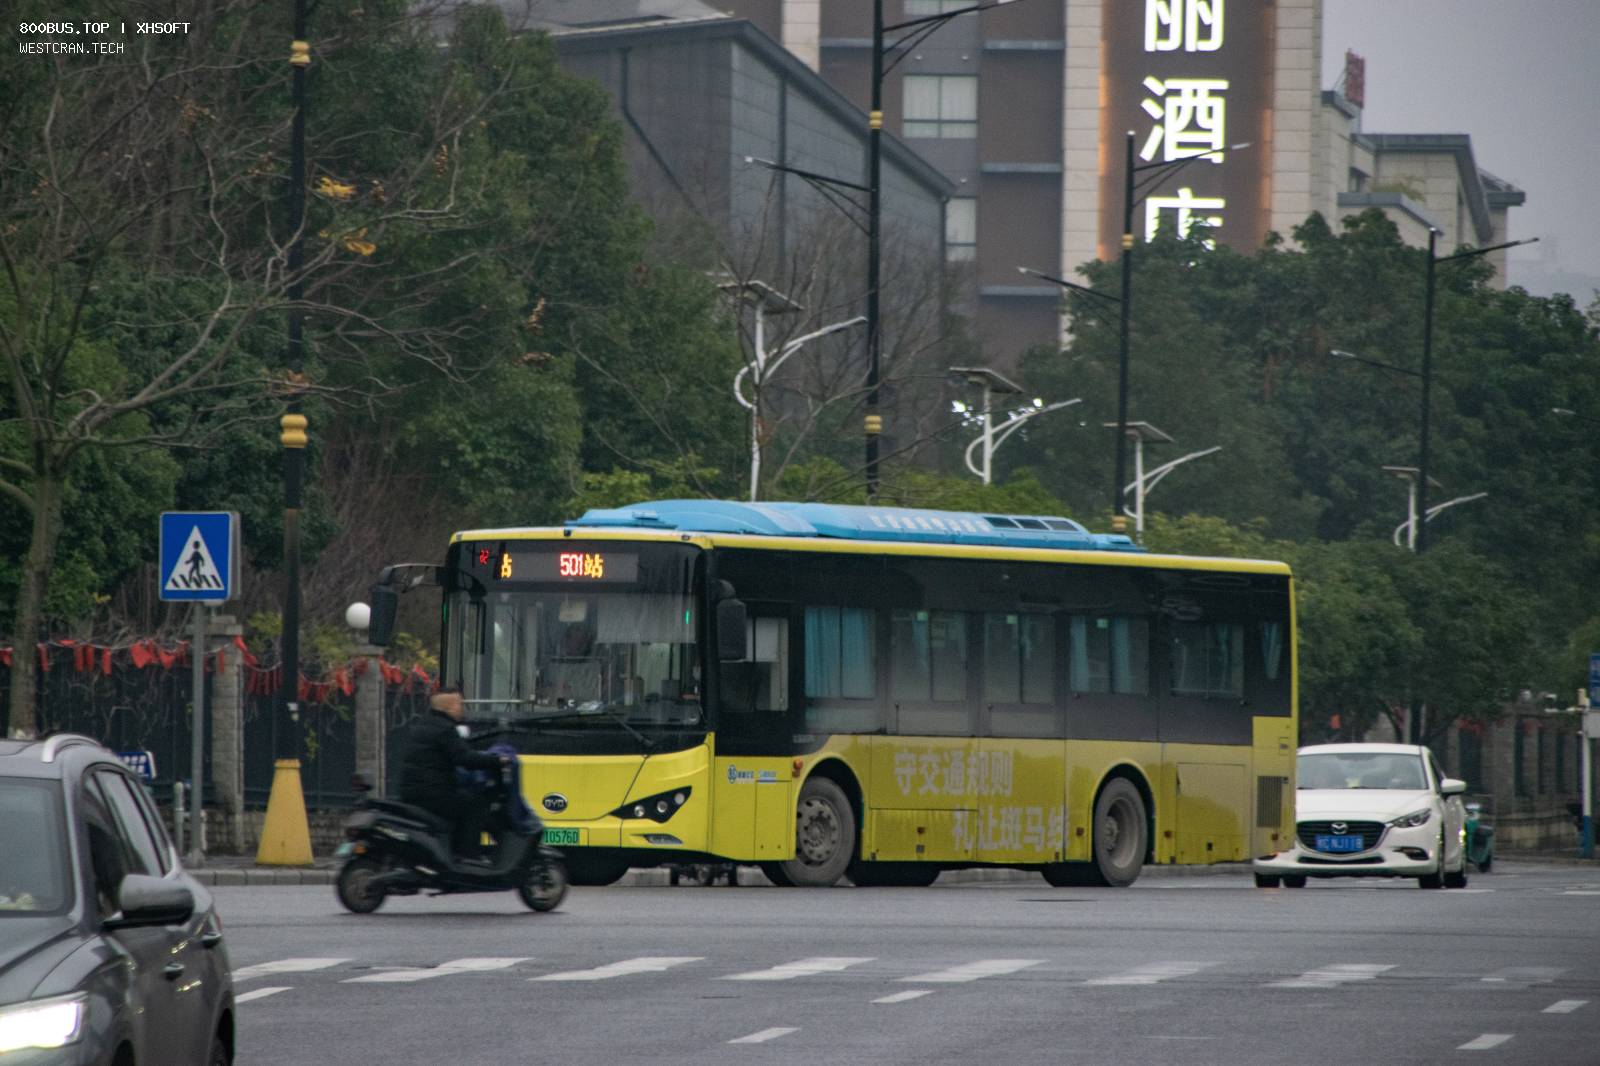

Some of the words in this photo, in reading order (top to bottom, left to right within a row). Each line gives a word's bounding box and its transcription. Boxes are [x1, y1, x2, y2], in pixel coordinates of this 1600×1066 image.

[895, 749, 1013, 796] 守交通规则
